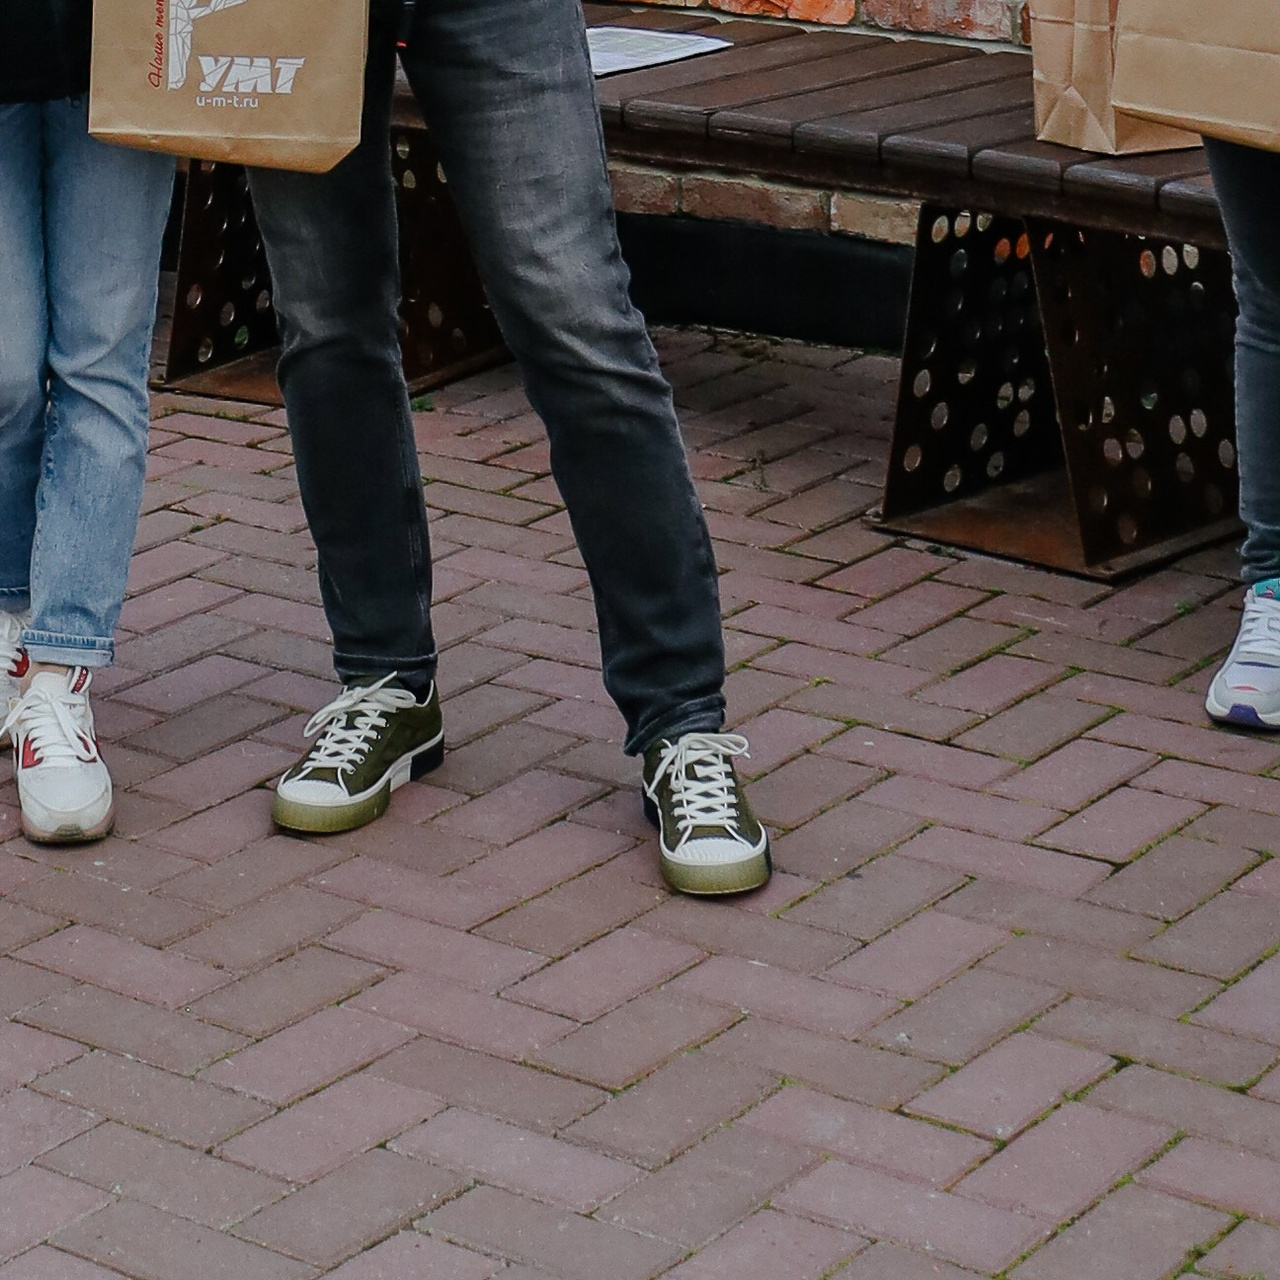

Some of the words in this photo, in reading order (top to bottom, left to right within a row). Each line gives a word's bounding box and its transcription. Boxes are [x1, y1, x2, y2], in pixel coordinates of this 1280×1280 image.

[148, 31, 163, 88] Наше
[198, 55, 306, 94] УМТ
[196, 95, 259, 108] u-m-t.ru
